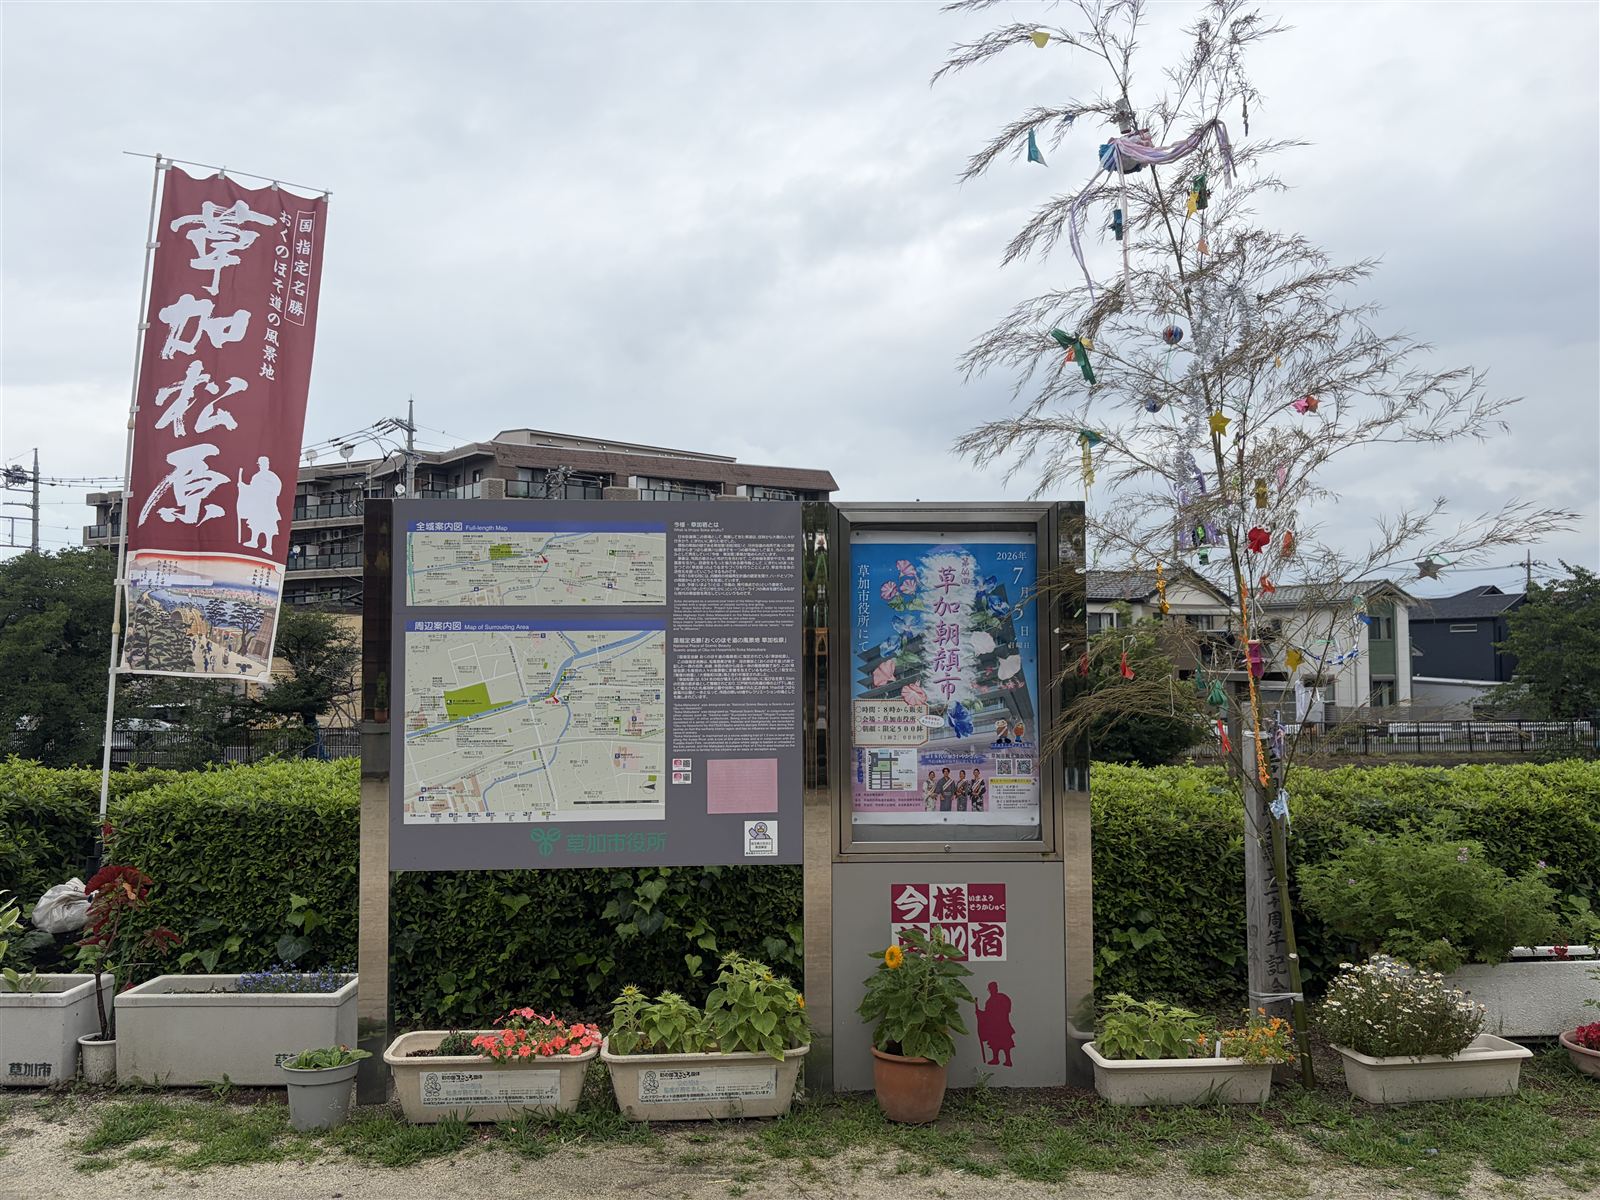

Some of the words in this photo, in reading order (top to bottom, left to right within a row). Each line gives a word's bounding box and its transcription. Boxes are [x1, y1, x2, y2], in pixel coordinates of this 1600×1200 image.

[259, 210, 292, 381] おくのほそ道の風景地
[287, 217, 314, 316] 国指定名勝
[137, 198, 277, 528] 草加松原
[996, 551, 1028, 561] 2026年
[857, 564, 871, 652] 草加市役所にて
[933, 566, 962, 700] 草加朝顔市
[567, 832, 667, 854] 草加市役所
[894, 885, 967, 921] 今様
[8, 1062, 52, 1077] 草加市
